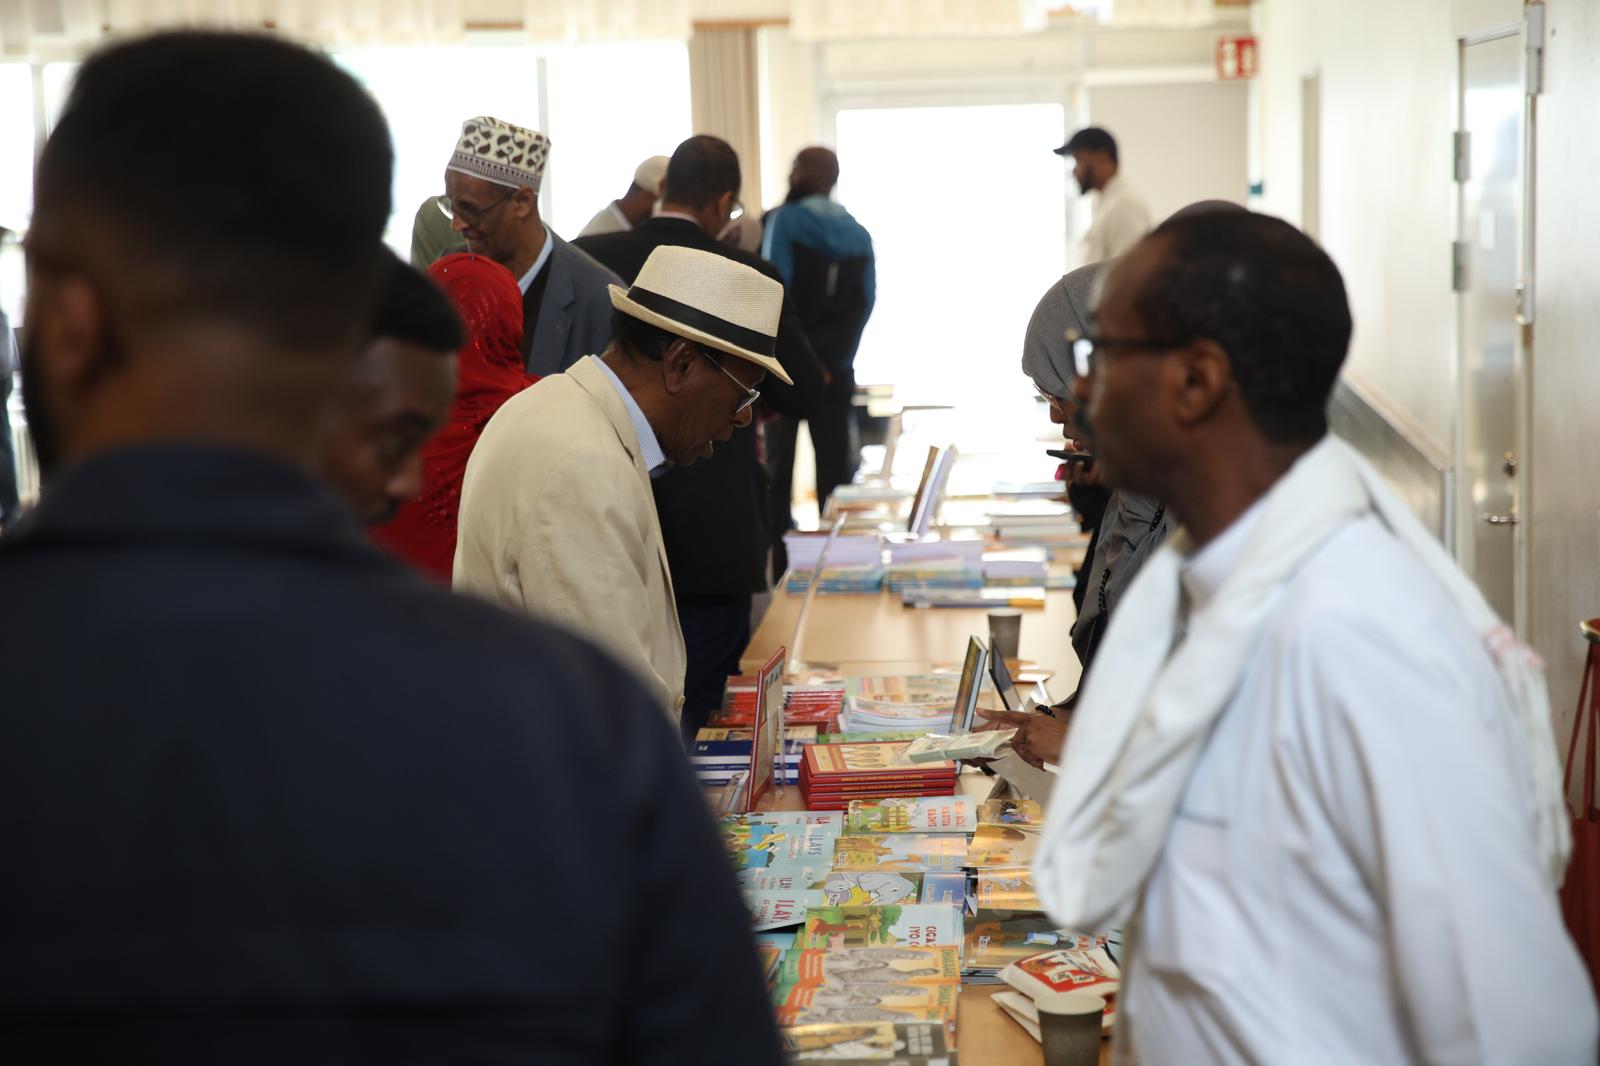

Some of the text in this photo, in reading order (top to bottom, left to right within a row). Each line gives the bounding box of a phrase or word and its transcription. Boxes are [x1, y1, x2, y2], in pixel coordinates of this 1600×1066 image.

[816, 816, 831, 825] ILA
[809, 834, 824, 856] ILAYS
[909, 926, 921, 939] IYO
